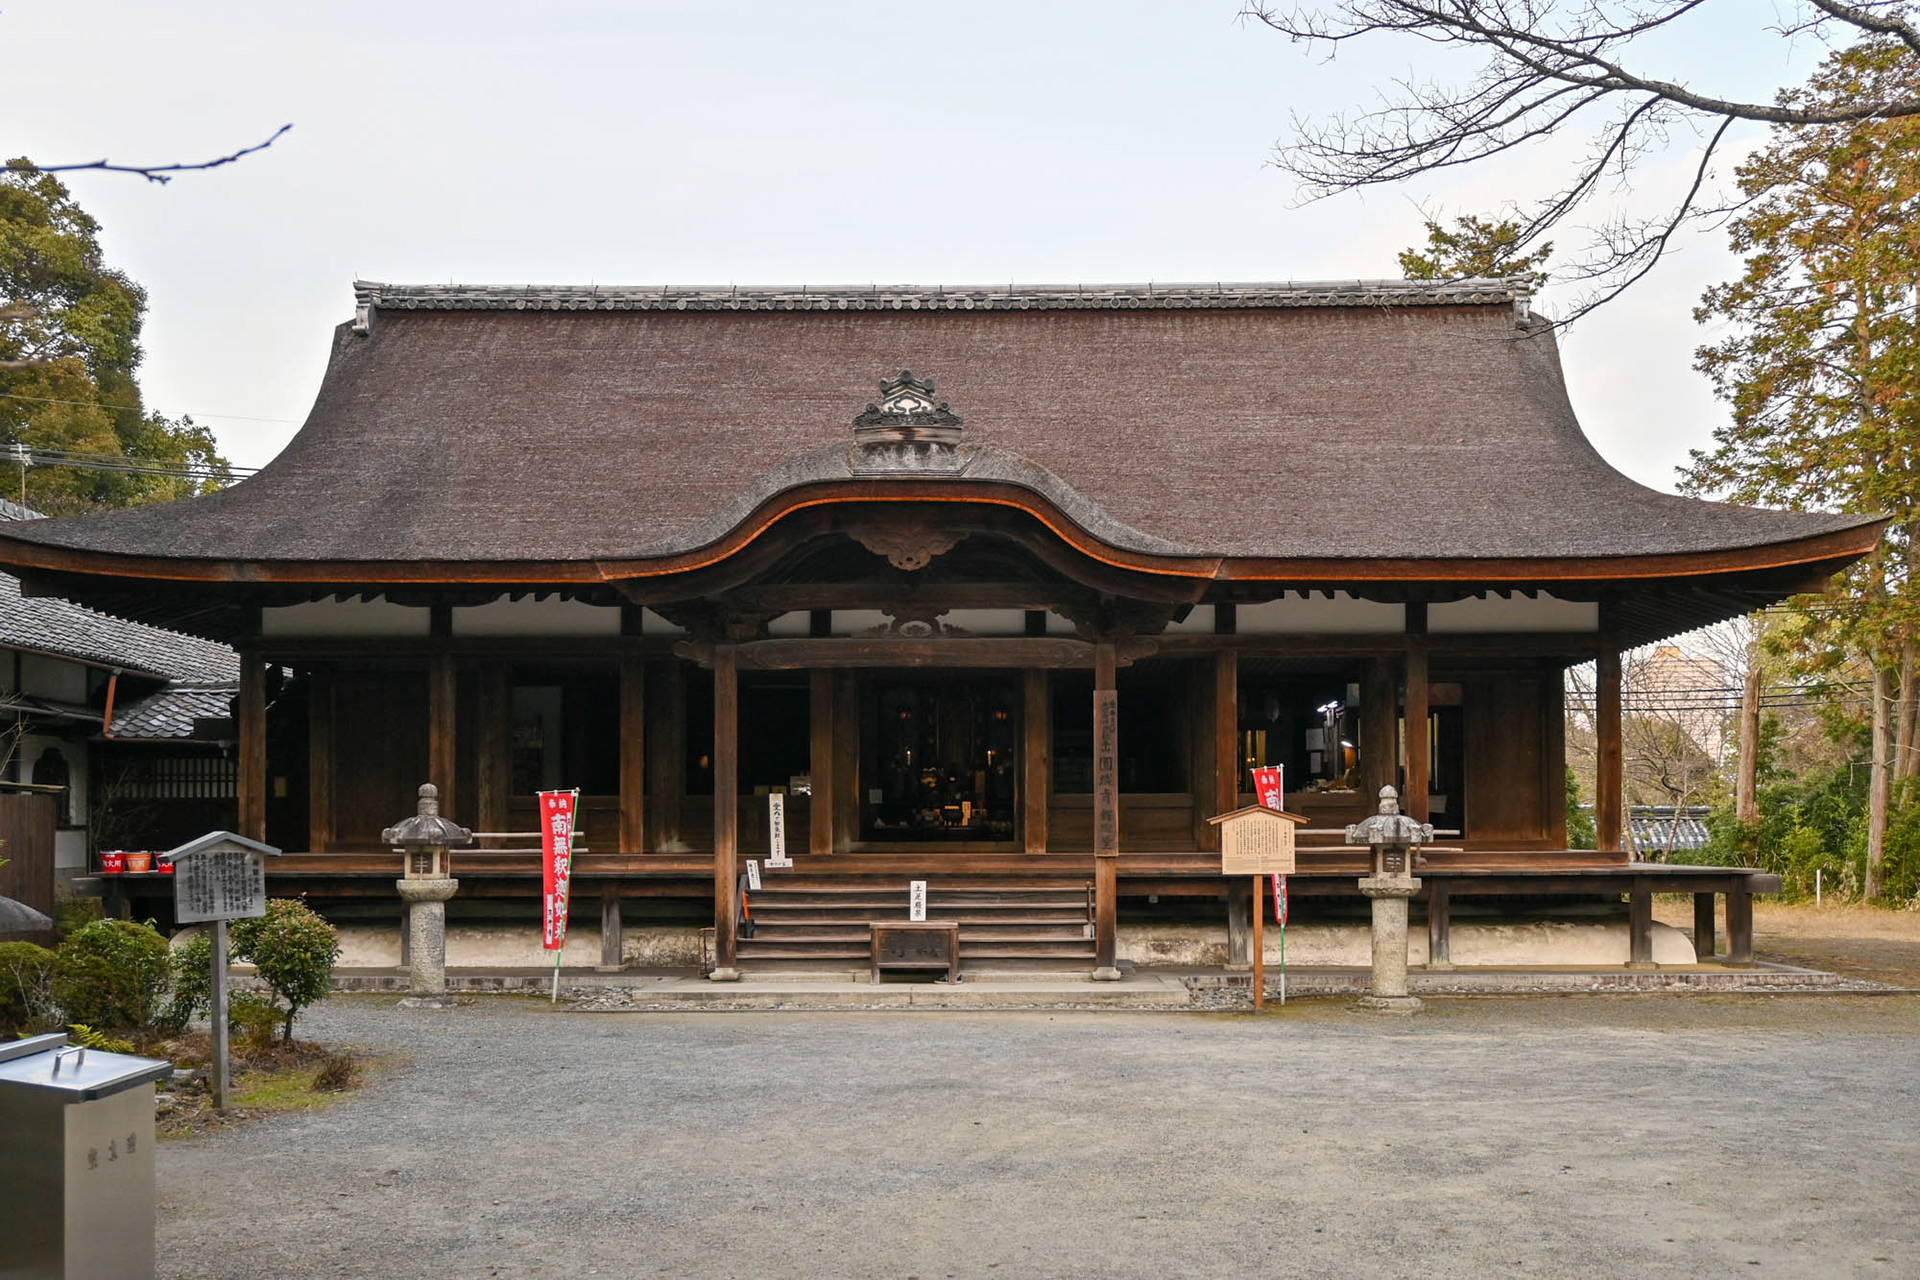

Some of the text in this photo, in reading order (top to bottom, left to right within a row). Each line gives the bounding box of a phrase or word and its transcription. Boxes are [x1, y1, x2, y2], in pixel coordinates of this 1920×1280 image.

[548, 798, 568, 809] 奉納
[914, 884, 923, 918] 土足厳禁
